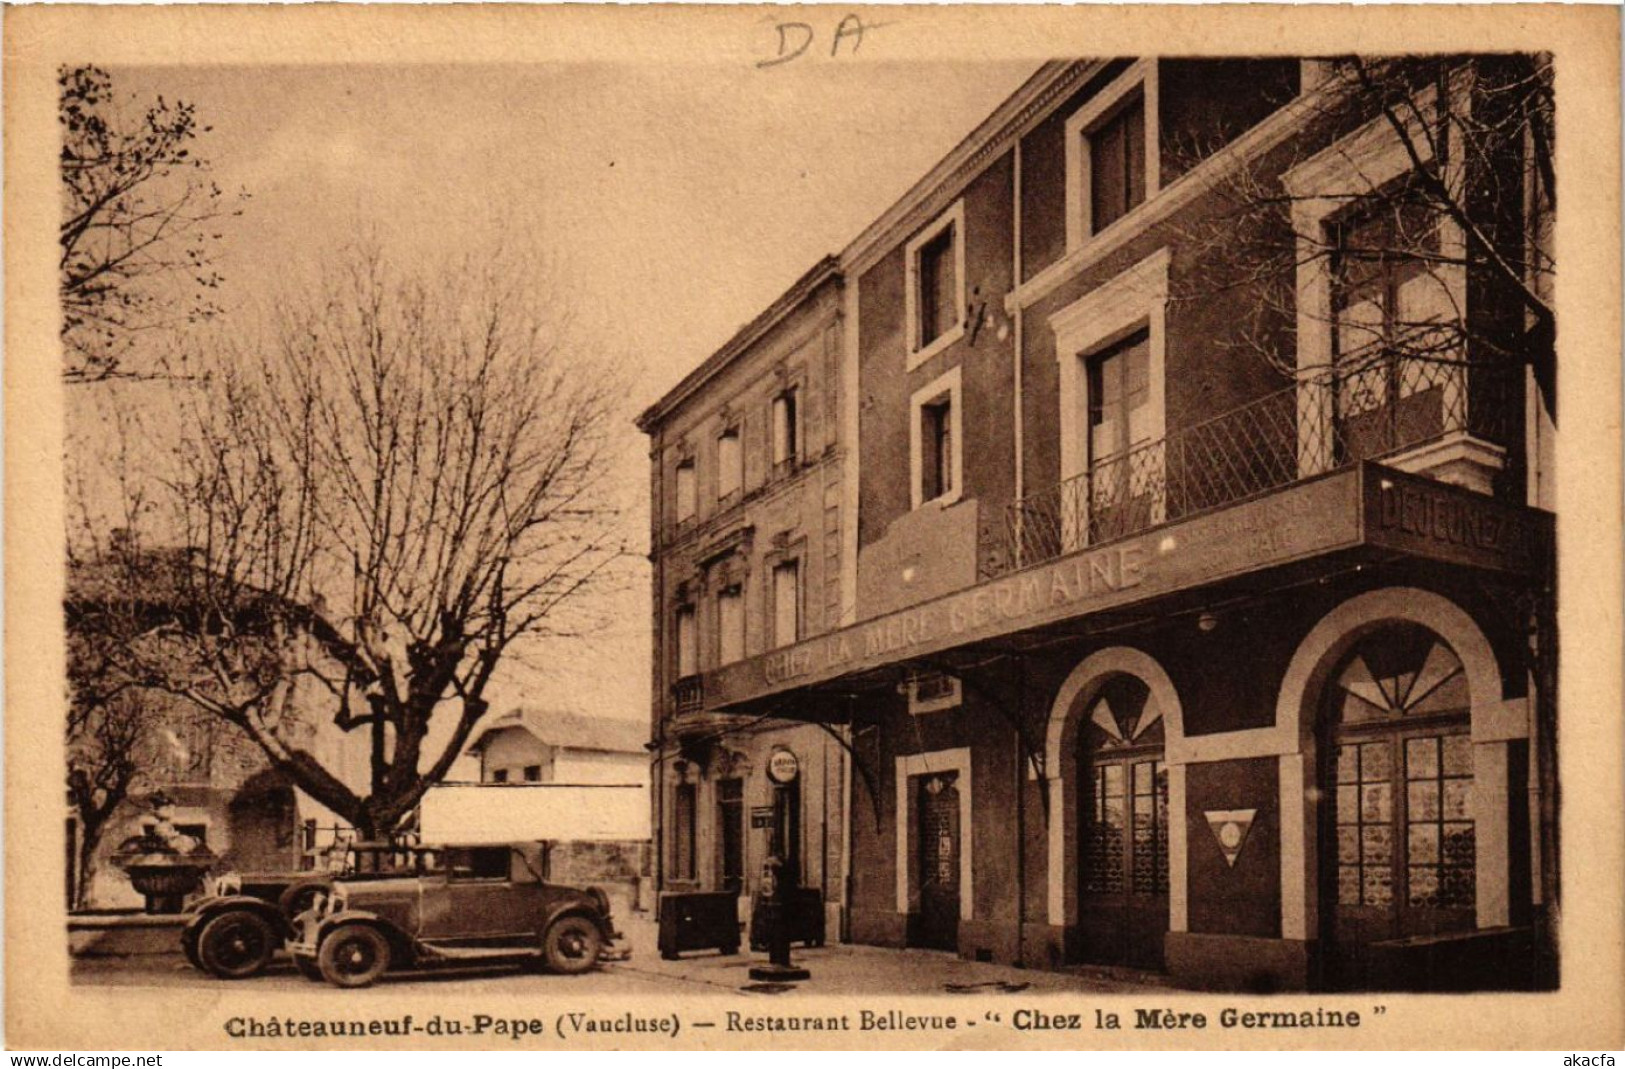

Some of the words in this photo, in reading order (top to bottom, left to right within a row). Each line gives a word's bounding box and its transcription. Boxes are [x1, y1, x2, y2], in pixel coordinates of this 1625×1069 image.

[765, 649, 811, 686] CHEZ
[827, 637, 850, 661] LA
[951, 549, 1143, 634] GERMAINE
